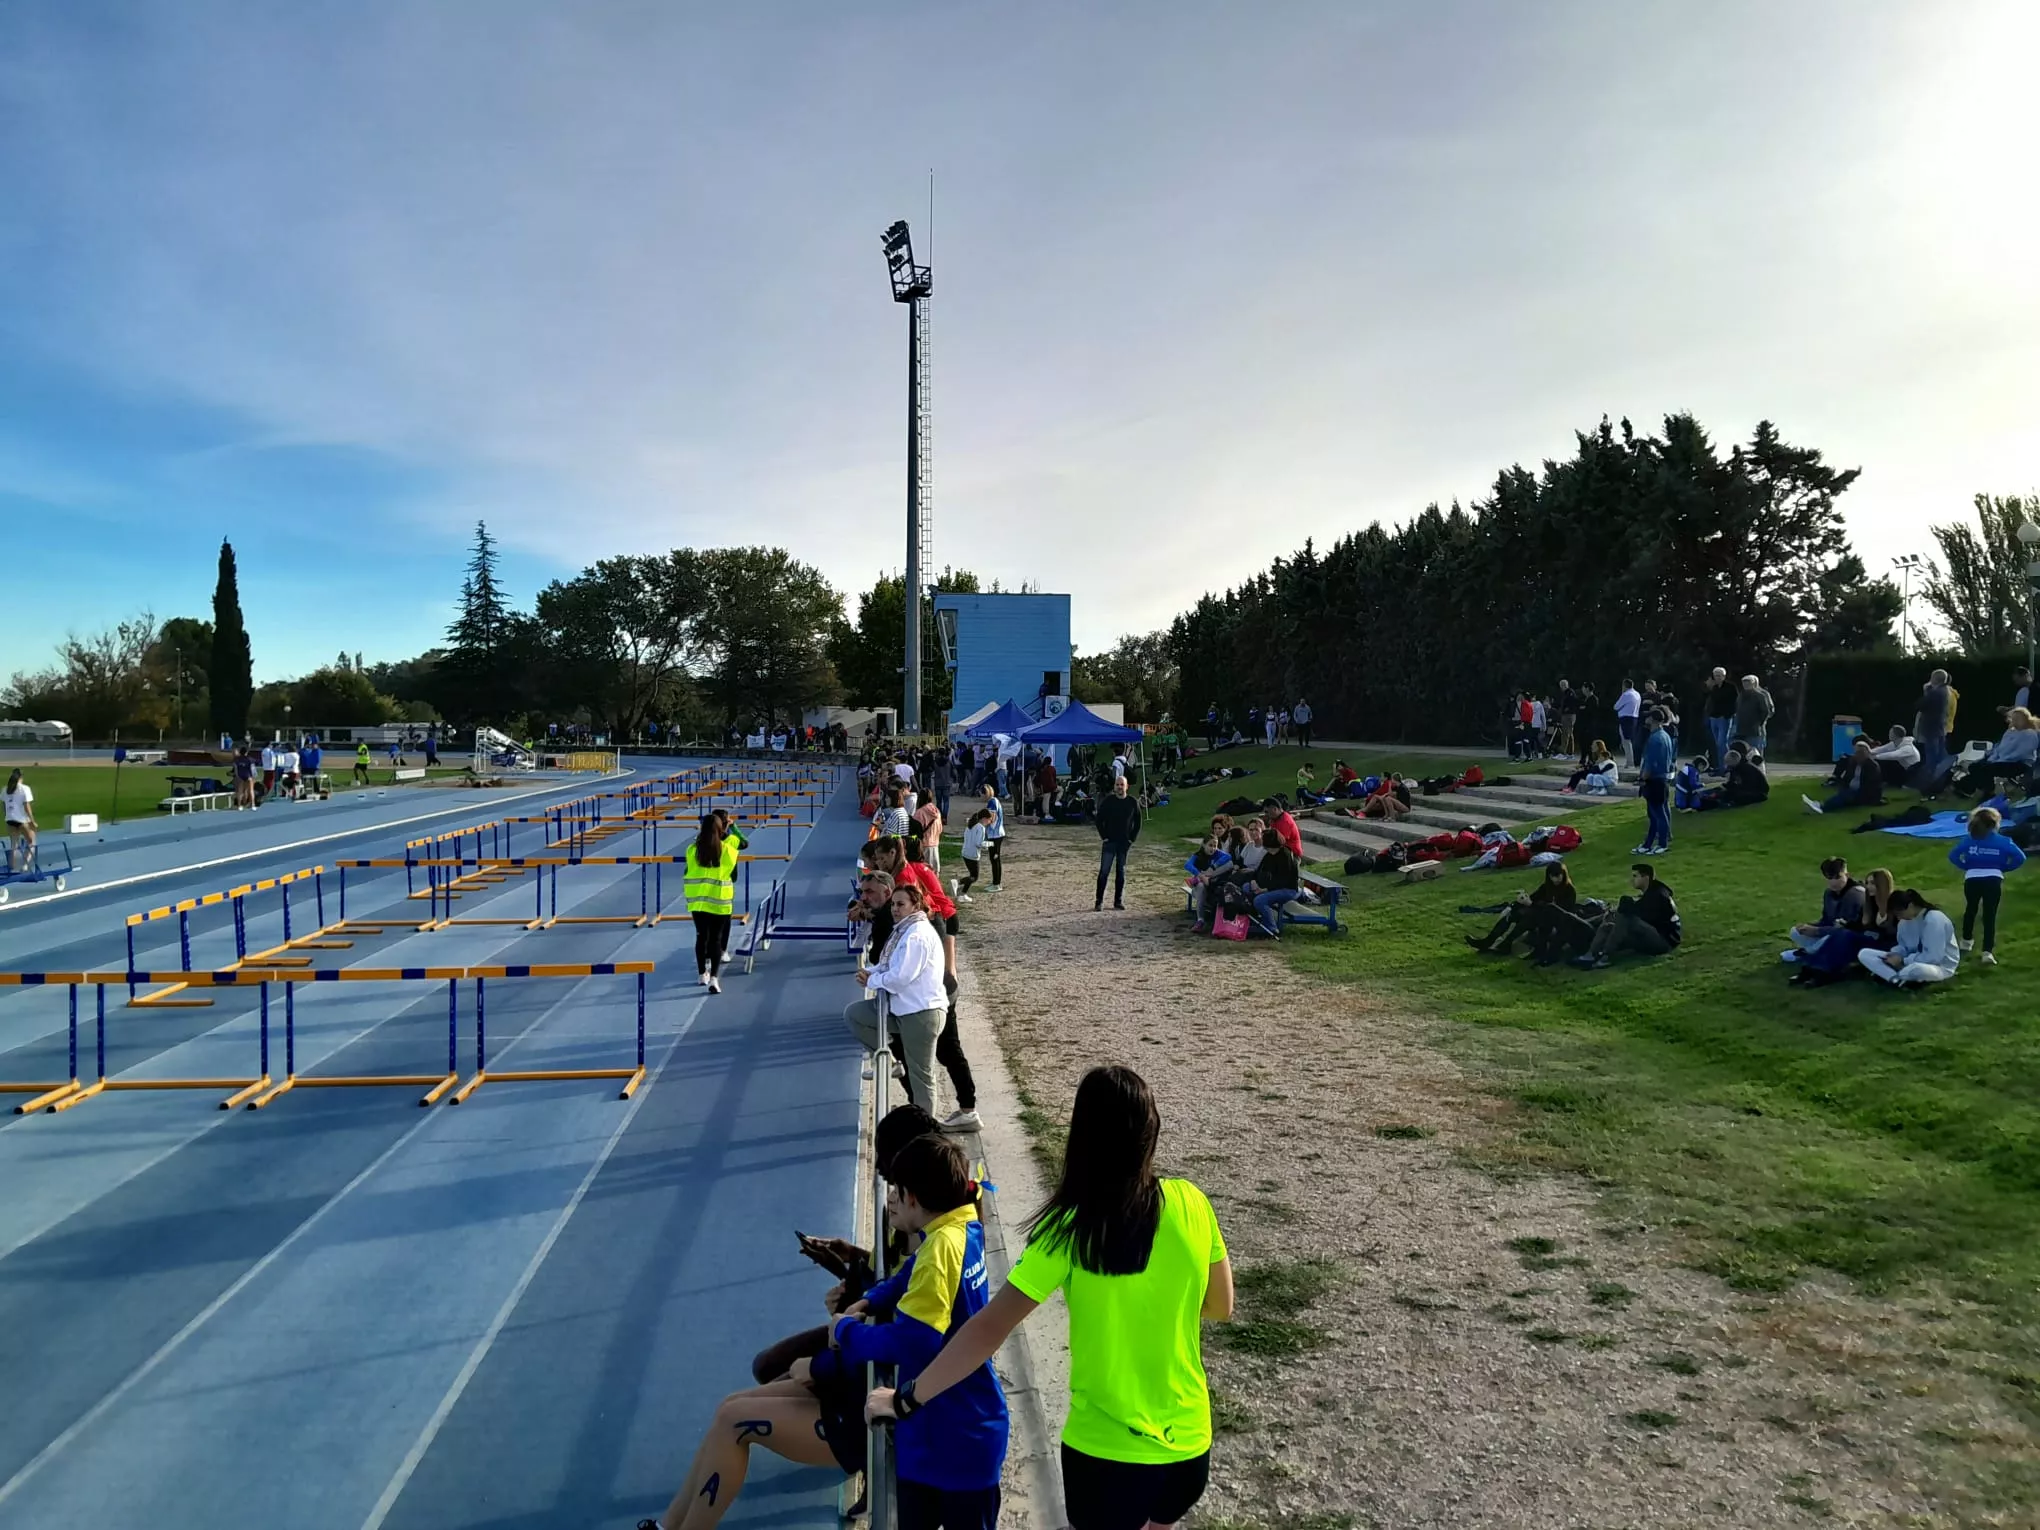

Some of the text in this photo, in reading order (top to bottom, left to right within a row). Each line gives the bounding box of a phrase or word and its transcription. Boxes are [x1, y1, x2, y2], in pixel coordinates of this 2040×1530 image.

[964, 1262, 981, 1278] CLUB
[700, 1420, 772, 1507] R A
